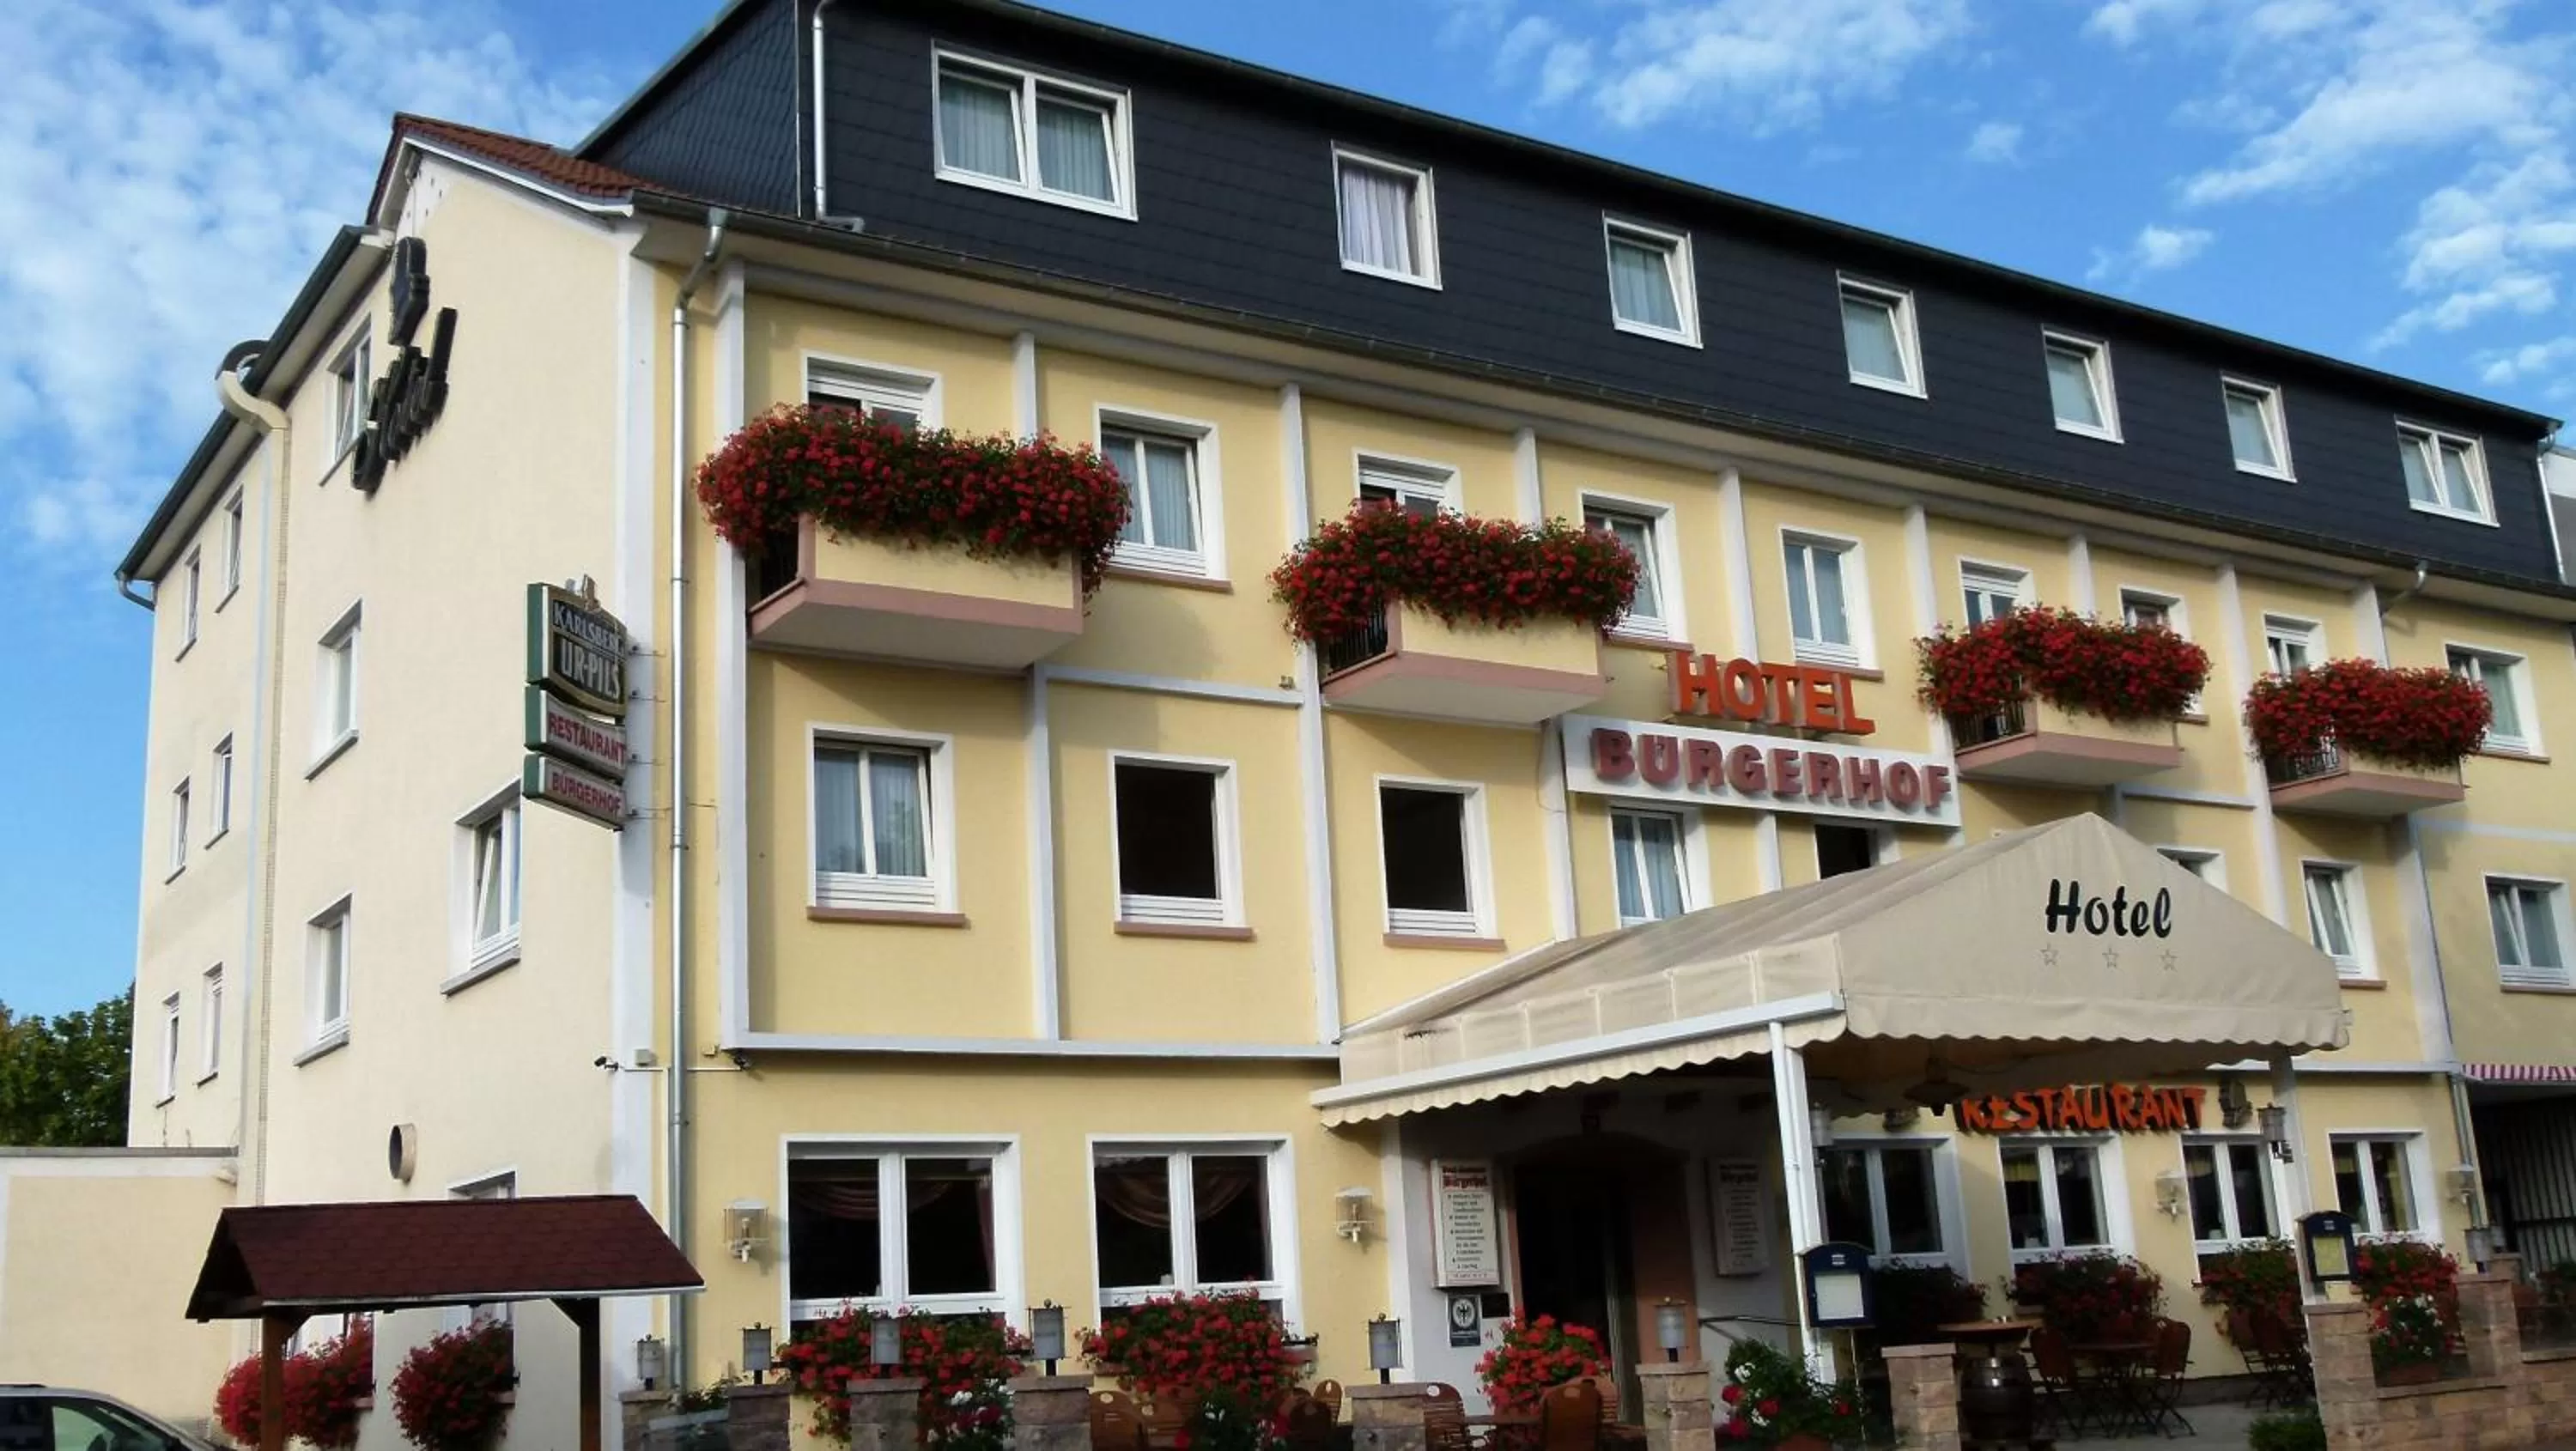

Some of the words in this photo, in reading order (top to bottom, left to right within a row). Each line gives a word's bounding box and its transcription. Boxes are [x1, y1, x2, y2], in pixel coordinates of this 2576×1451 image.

[1668, 651, 1876, 736] HOTEL
[548, 711, 627, 765] RESTAURANT
[2045, 878, 2172, 938] Hotel
